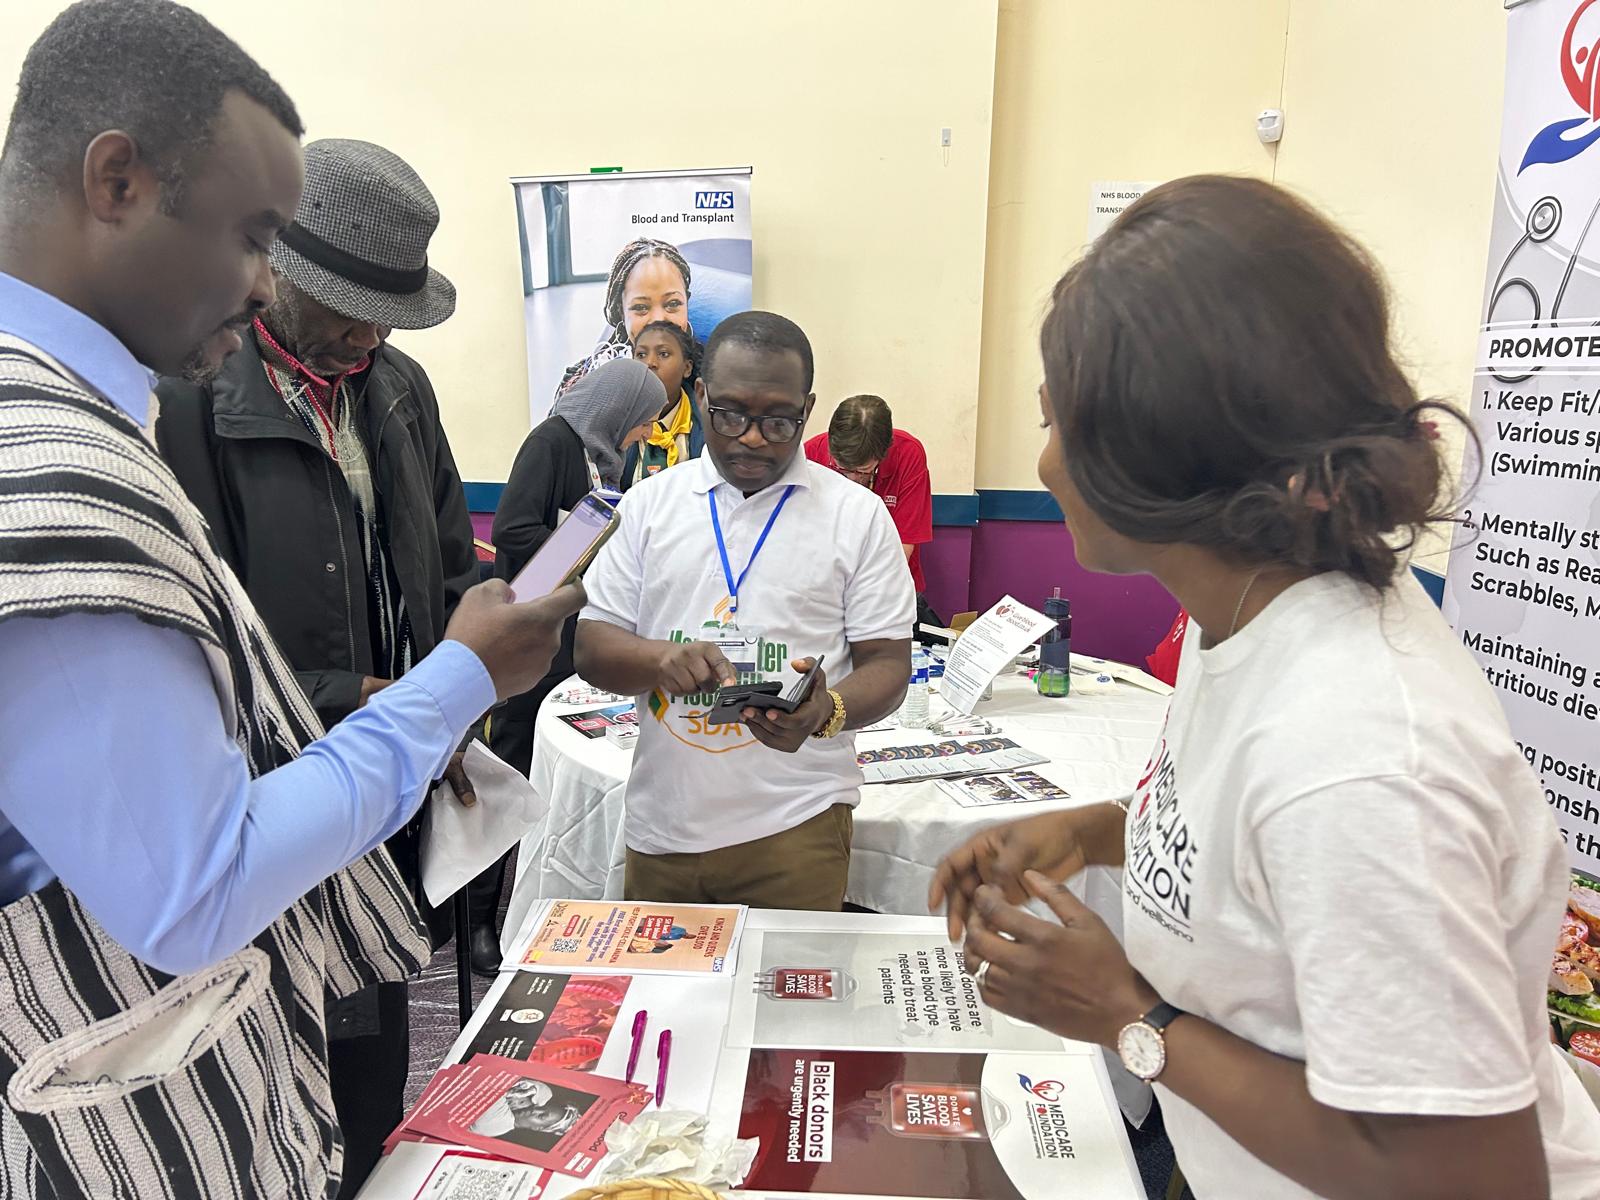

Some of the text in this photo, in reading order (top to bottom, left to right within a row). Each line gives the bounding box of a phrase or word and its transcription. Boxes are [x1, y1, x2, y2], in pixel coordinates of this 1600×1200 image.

[696, 192, 732, 208] NHS
[632, 213, 734, 224] Blood and Transplant
[1489, 336, 1600, 358] PROMOTE
[1483, 390, 1600, 416] 1. Keep Fit/
[1497, 422, 1579, 445] Various
[1462, 510, 1474, 529] 2.
[1481, 513, 1576, 549] Mentally
[1476, 542, 1530, 569] Such
[1537, 556, 1560, 575] as
[1471, 571, 1578, 617] Scrabbles,
[1463, 629, 1587, 687] Maintaining
[1482, 666, 1600, 720] tritious die
[1154, 750, 1199, 884] MEDICARE
[1541, 779, 1600, 825] onsh
[693, 926, 709, 949] GIVE BLOOD
[713, 918, 725, 931] KINGS
[704, 942, 719, 957] QUEENS
[713, 957, 723, 972] NHS
[918, 958, 930, 974] rare
[786, 975, 795, 993] LIVES
[797, 975, 807, 993] SAVE
[878, 968, 895, 1004] patients
[898, 953, 919, 1022] needed to treat
[921, 977, 938, 1002] blood
[935, 948, 962, 1032] more likely to have
[961, 977, 978, 1009] donors
[923, 1004, 940, 1026] type
[968, 1011, 982, 1027] are
[787, 1059, 805, 1162] are urgently needed
[809, 1065, 830, 1158] Black donors
[906, 1094, 921, 1124] LIVES
[921, 1094, 937, 1125] SAVE
[937, 1095, 950, 1126] BLOOD
[950, 1096, 960, 1126] DONATE
[1035, 1103, 1059, 1158] FOUNDATION
[1048, 1104, 1075, 1159] MEDICARE
